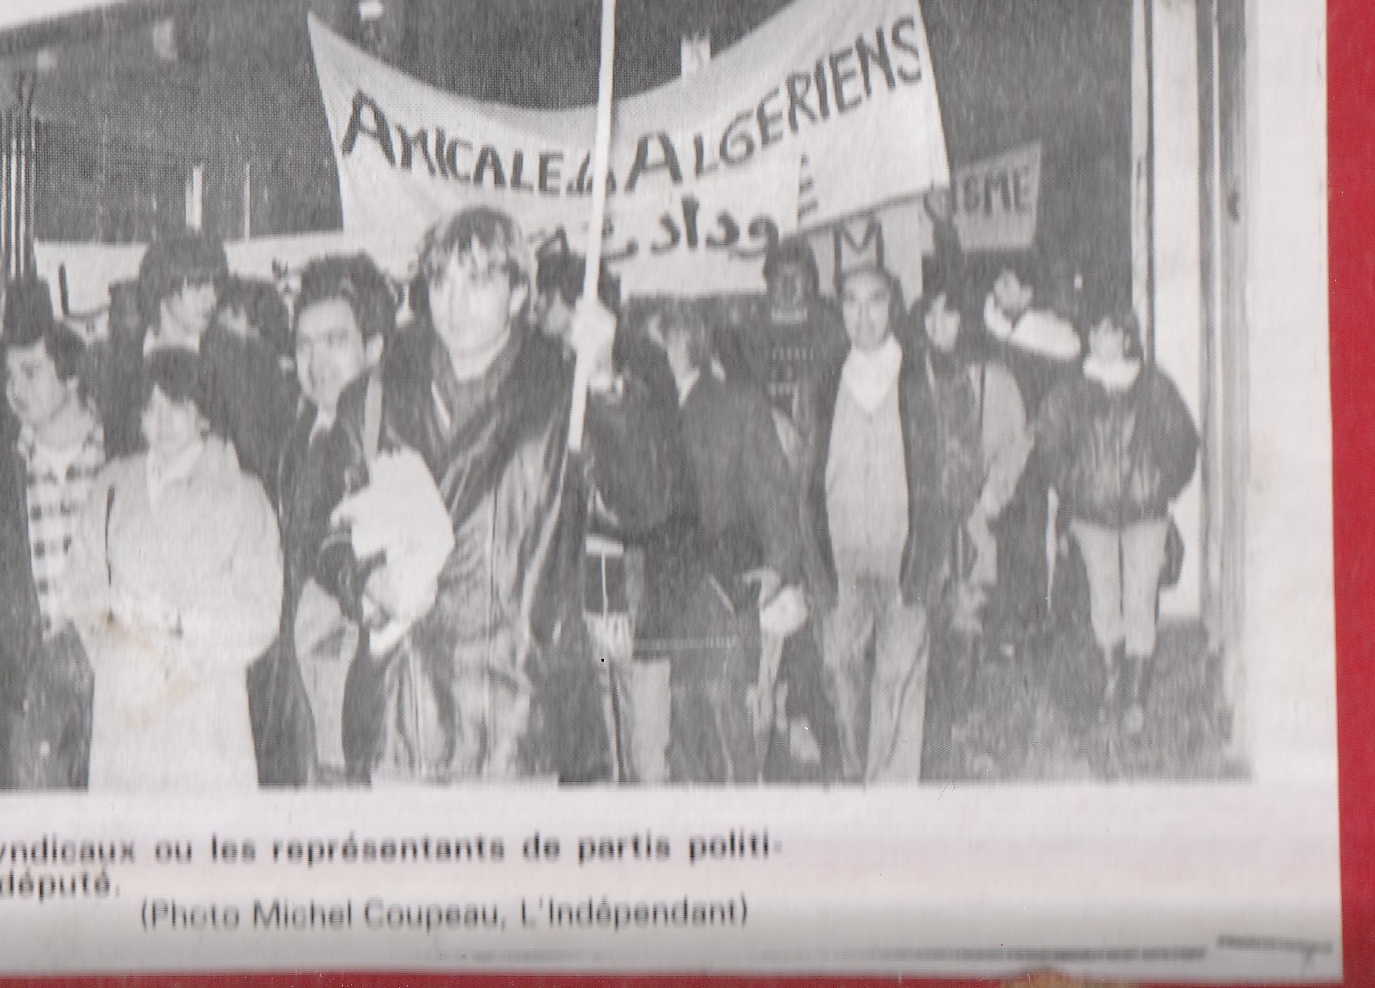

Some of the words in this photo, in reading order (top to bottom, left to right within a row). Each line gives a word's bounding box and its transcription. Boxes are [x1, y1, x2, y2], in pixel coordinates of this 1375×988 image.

[624, 15, 923, 195] ALGERIENS
[153, 840, 194, 865] ou
[210, 835, 257, 865] les
[271, 835, 506, 870] représentants
[521, 835, 562, 863] de
[577, 835, 672, 868] partis
[140, 899, 240, 930] (Photo
[252, 898, 353, 930] Michel
[363, 898, 505, 934] Coupeau,
[520, 895, 748, 932] L'Indépendant)
